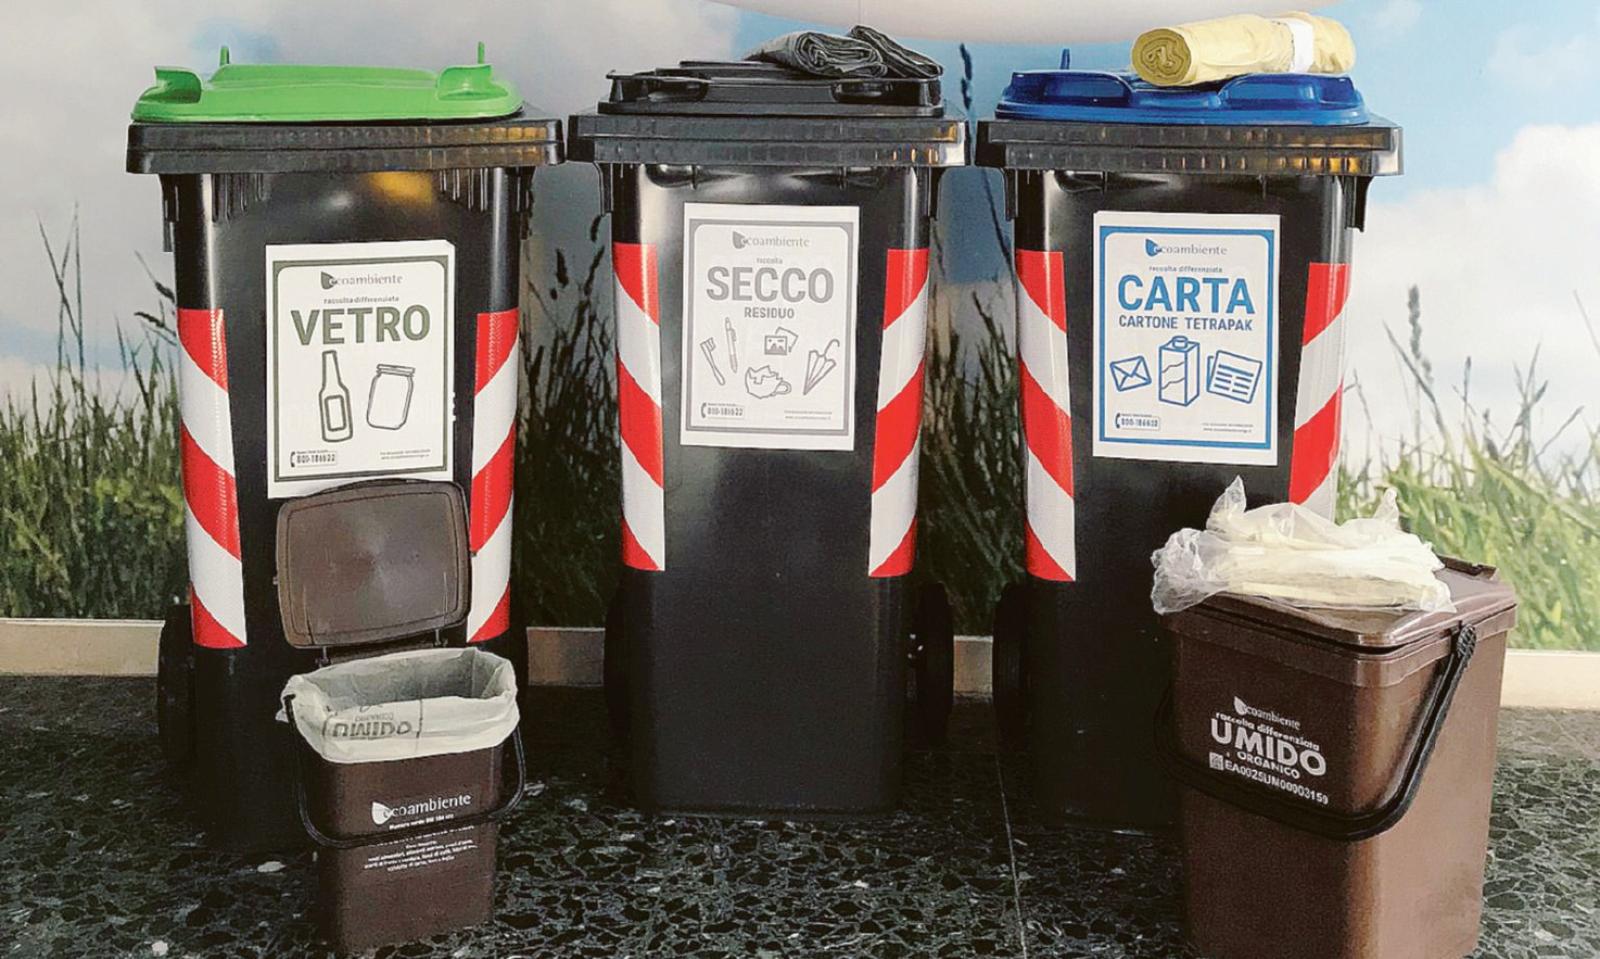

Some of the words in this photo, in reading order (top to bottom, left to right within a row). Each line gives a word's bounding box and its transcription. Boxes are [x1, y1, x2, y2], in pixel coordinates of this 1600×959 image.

[706, 266, 834, 303] SECCO
[1118, 274, 1255, 314] CARTA
[290, 304, 431, 346] VETRO
[744, 307, 795, 319] RESIDUO
[1119, 315, 1178, 329] CARTONE
[1184, 317, 1253, 331] TETRAPAK
[1211, 718, 1326, 776] UMIDO
[1215, 712, 1255, 730] raccolta
[1257, 723, 1320, 751] differenziata
[1237, 751, 1300, 779] ORGANICO
